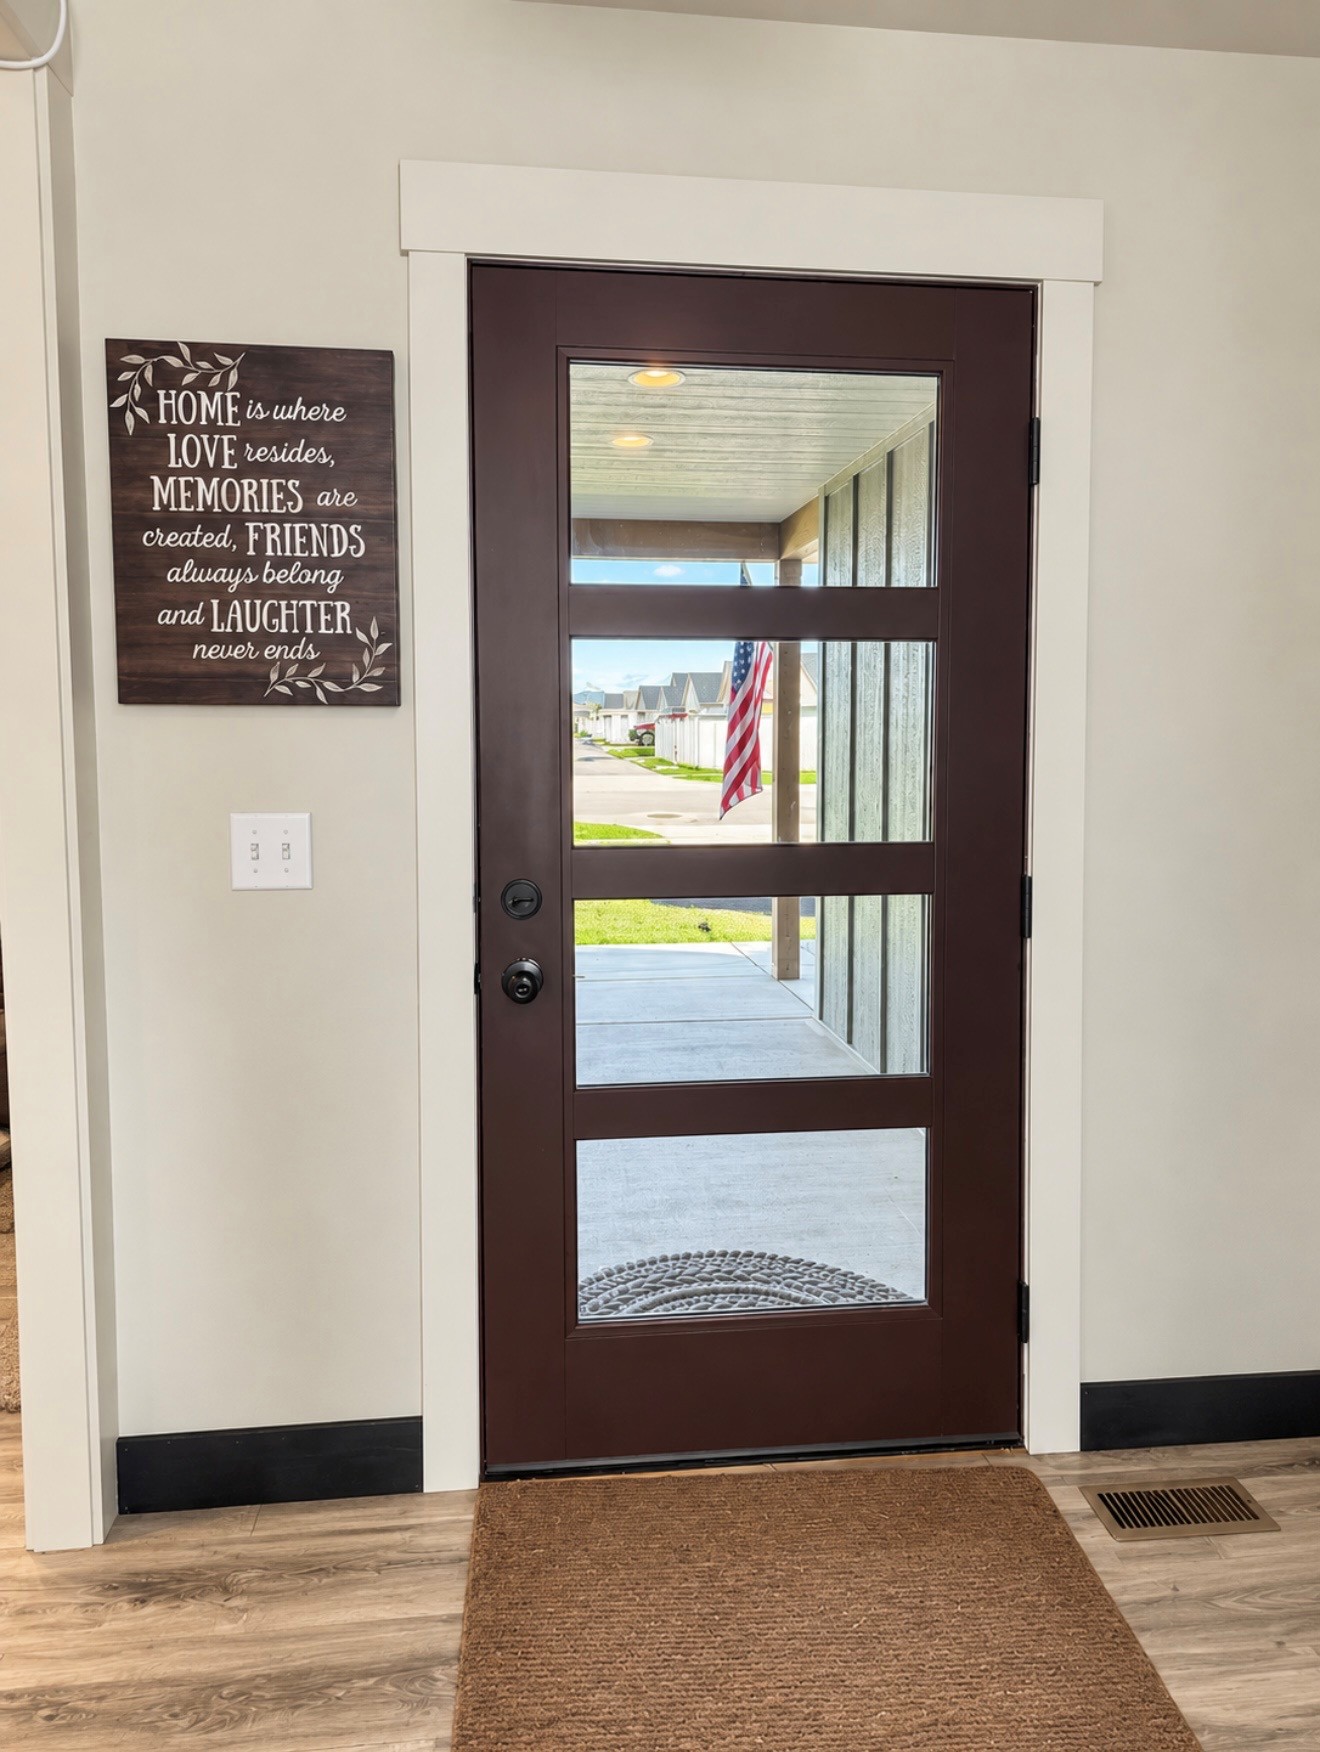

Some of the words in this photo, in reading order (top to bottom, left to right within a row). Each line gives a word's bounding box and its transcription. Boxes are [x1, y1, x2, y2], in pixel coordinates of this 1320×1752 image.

[157, 390, 240, 426] HOME
[247, 400, 270, 419] is
[273, 397, 346, 422] where
[167, 434, 237, 469] LOVE
[244, 439, 334, 467] resides,
[150, 476, 303, 513] MEMORIES
[317, 488, 358, 507] are
[143, 524, 236, 551] created,
[245, 523, 365, 557] FRIENDS
[167, 559, 259, 593] always
[263, 561, 344, 593] belong
[158, 602, 204, 625] and
[211, 599, 352, 633] LAUGHTER
[193, 642, 259, 659] never
[264, 637, 320, 660] ends
